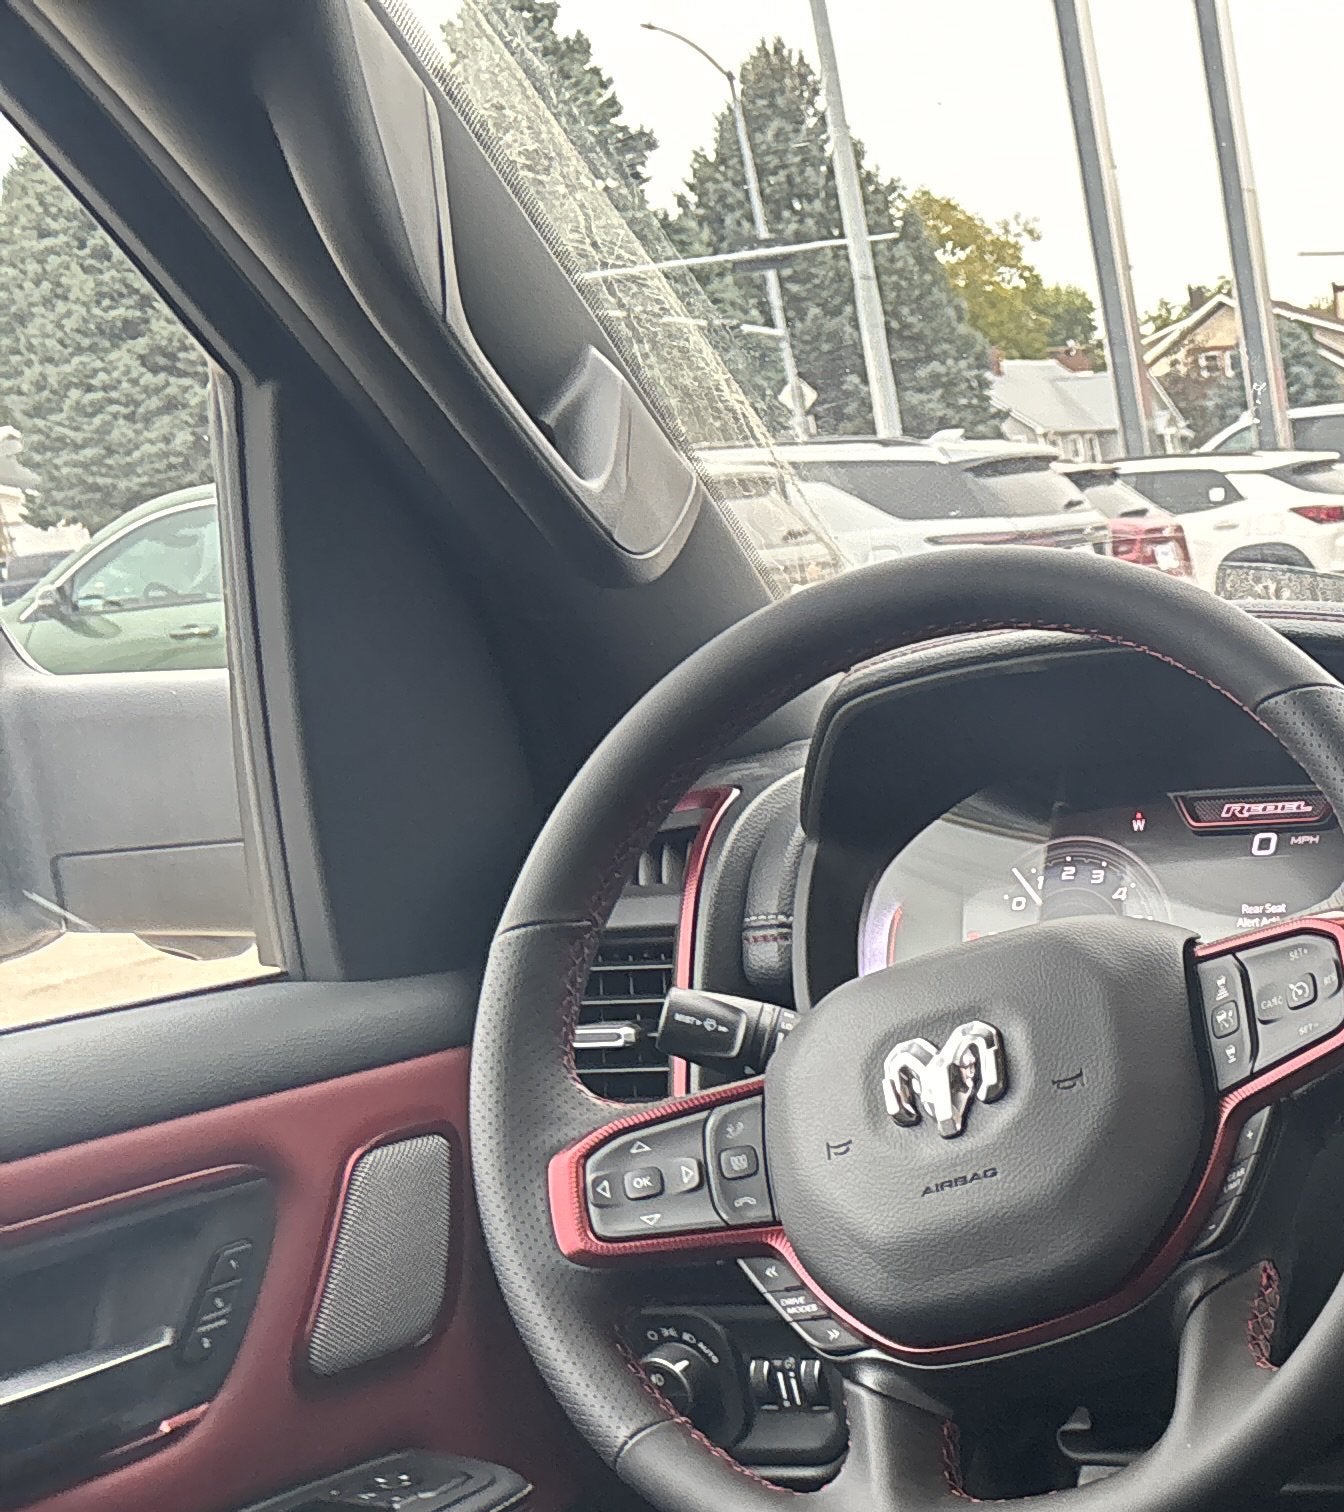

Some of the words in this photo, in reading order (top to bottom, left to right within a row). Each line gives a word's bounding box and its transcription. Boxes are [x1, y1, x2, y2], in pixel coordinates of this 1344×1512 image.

[1220, 800, 1313, 818] REBEL
[1132, 818, 1146, 832] W
[1251, 832, 1278, 856] 0
[1290, 835, 1320, 845] MPH
[1062, 866, 1076, 880] 2
[1090, 869, 1104, 884] 3
[1037, 875, 1045, 889] 1
[1112, 886, 1128, 901] 4
[1011, 896, 1027, 911] 0
[1241, 903, 1264, 914] Rear
[1264, 903, 1287, 914] Seat
[1236, 917, 1260, 928] Alert
[632, 1176, 653, 1189] OK
[921, 1167, 998, 1197] AIRBAG
